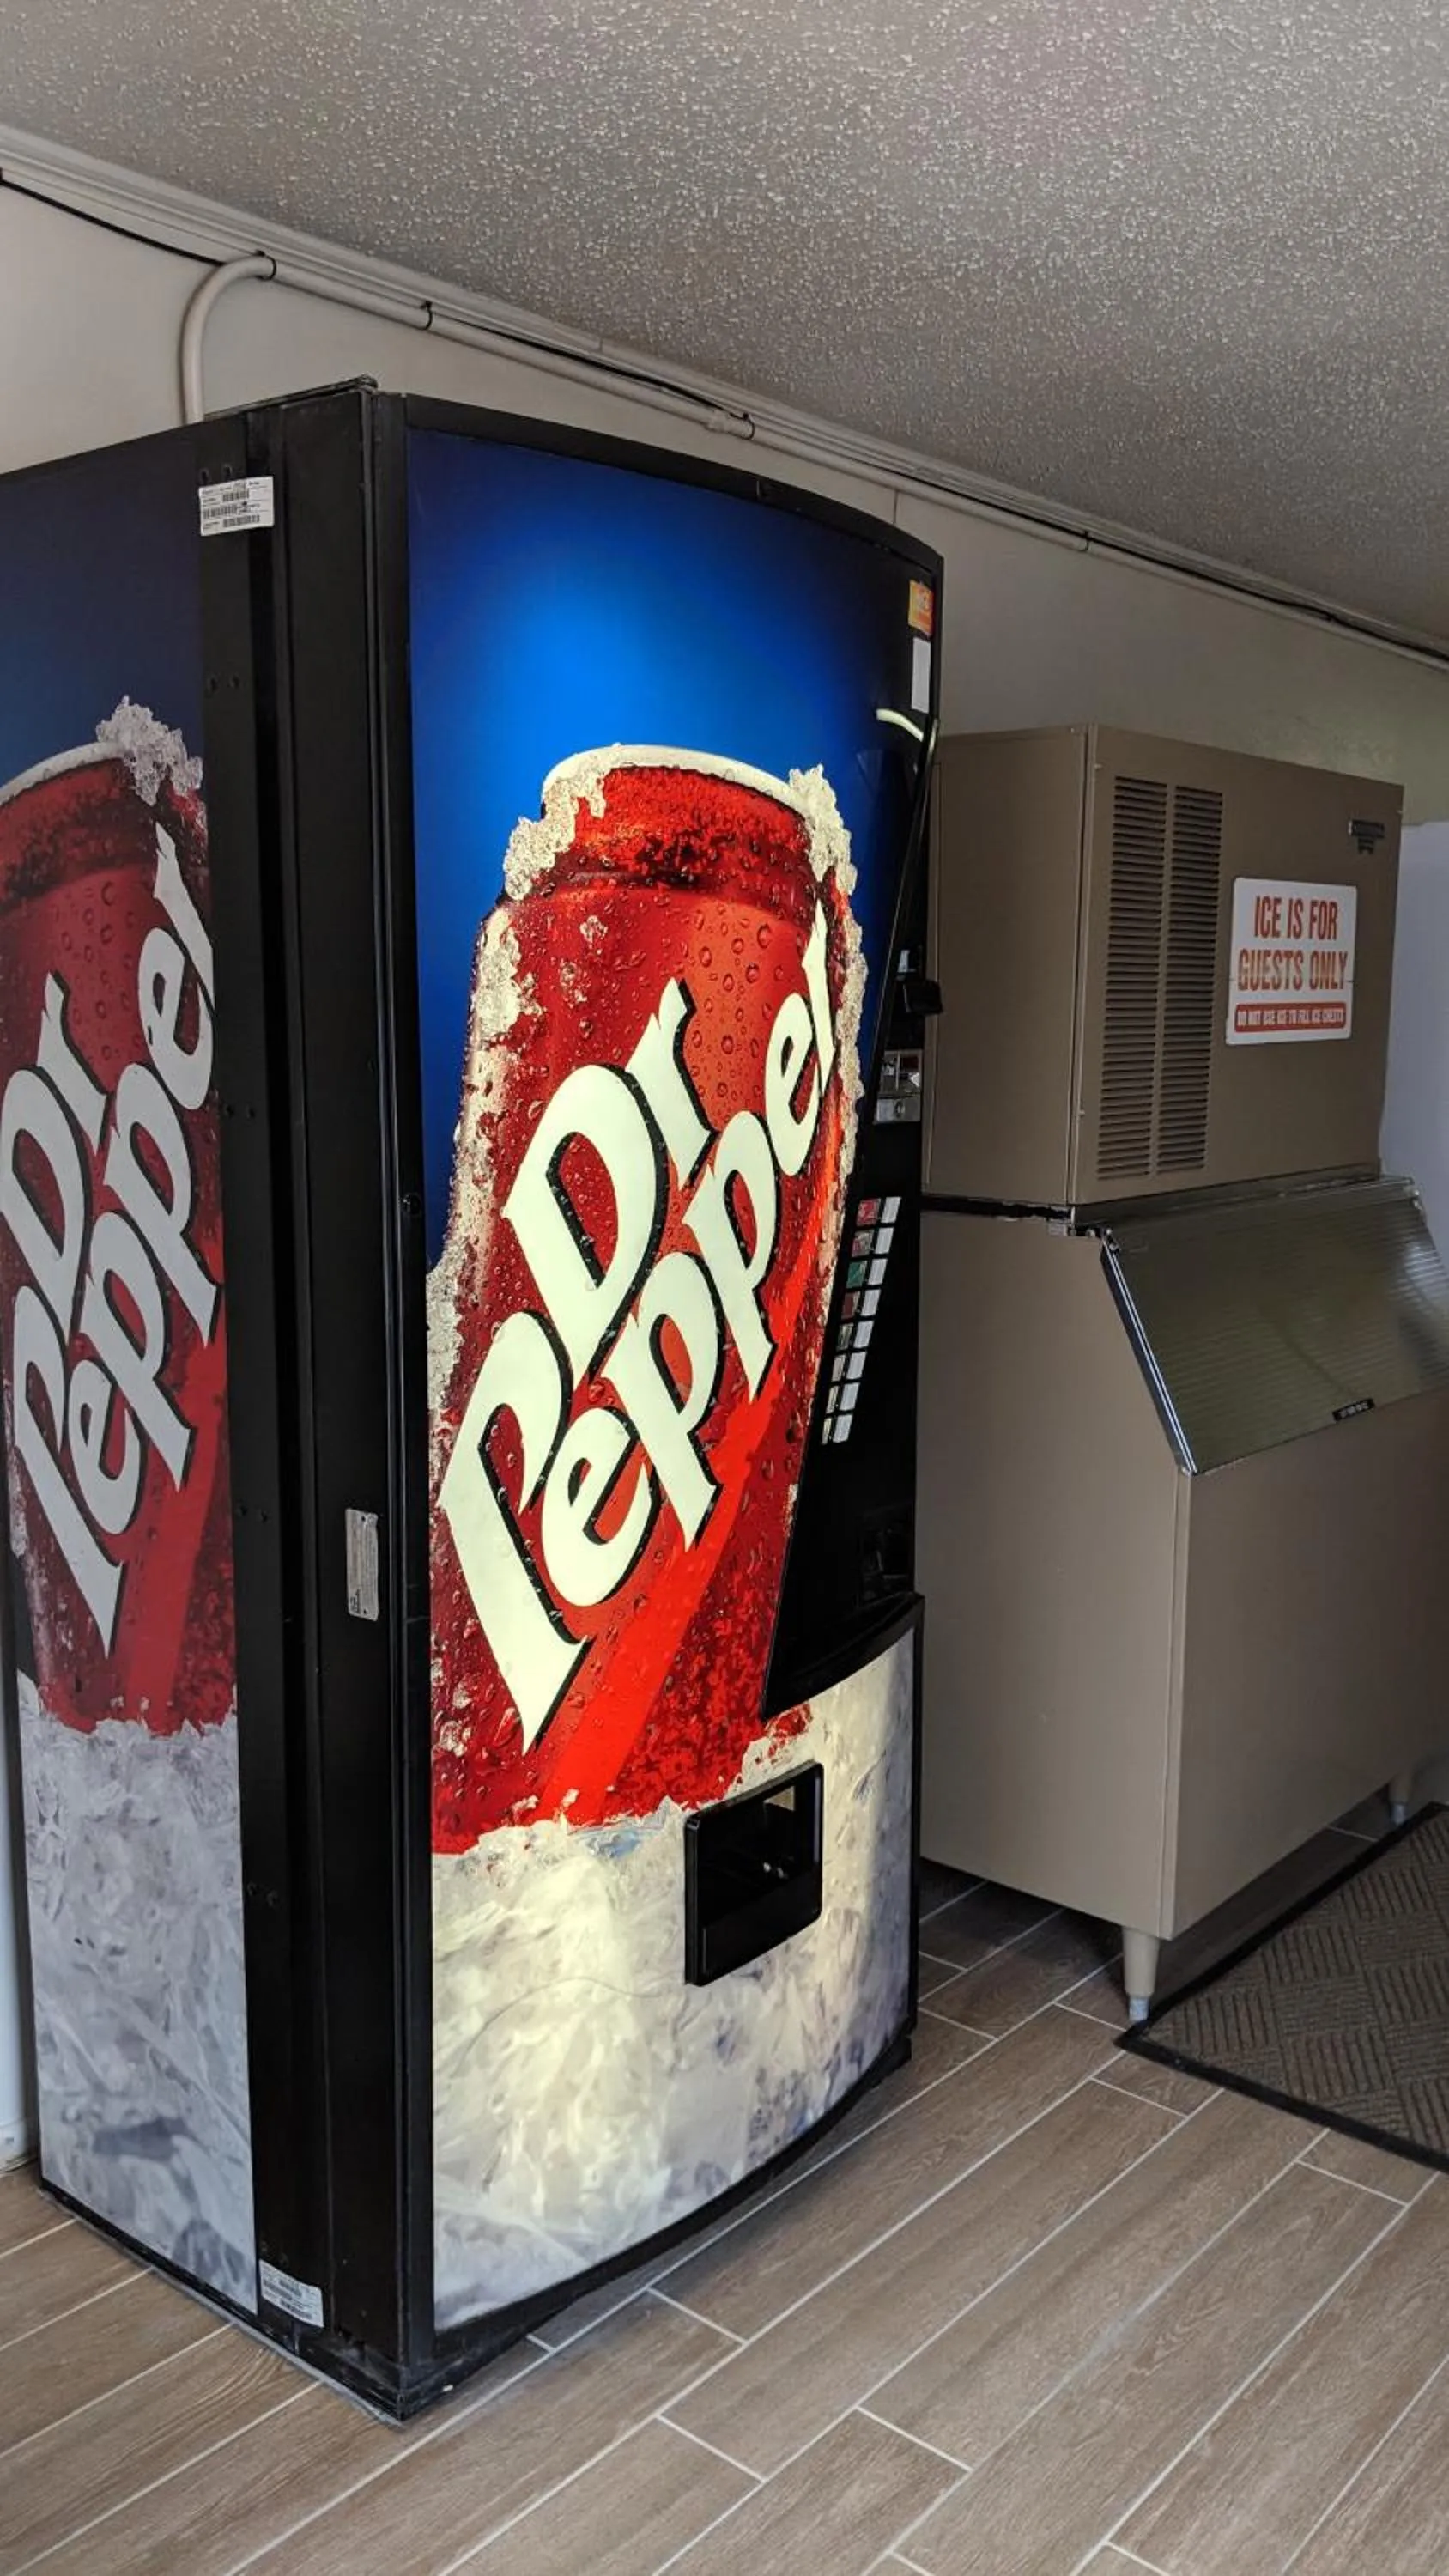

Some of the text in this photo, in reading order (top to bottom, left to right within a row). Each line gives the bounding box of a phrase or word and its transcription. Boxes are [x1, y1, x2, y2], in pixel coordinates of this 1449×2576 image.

[1238, 948, 1348, 991] GUESTS ONLY
[1254, 895, 1338, 940] ICE IS FOR
[0, 971, 108, 1346] Dr
[437, 900, 840, 1754] Pepper
[501, 975, 714, 1387] Dr
